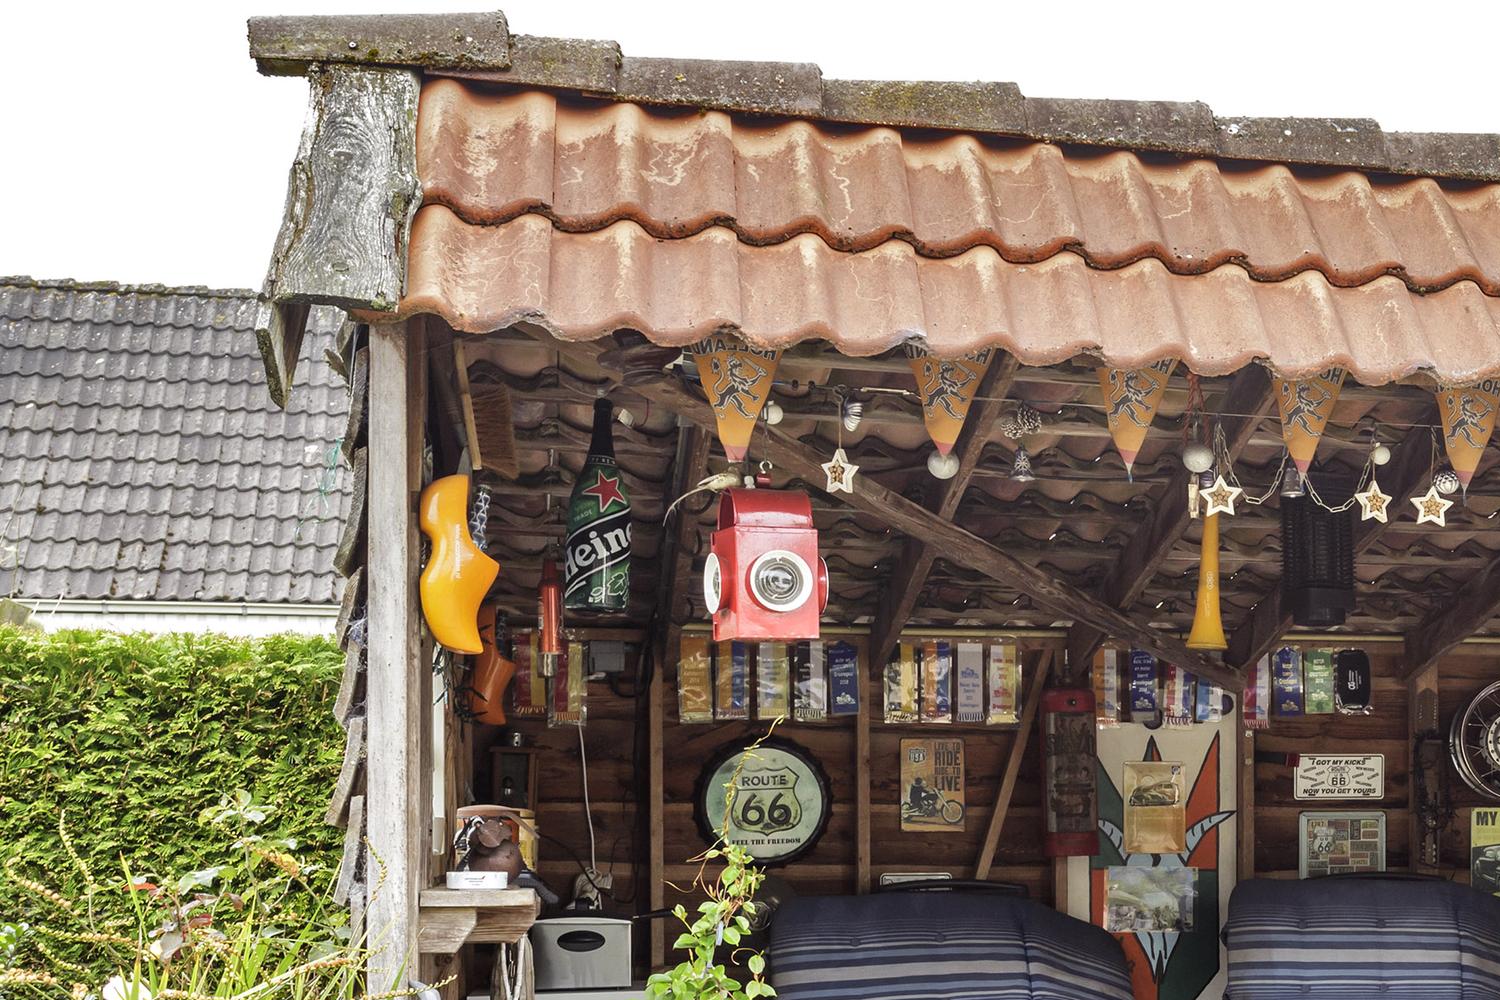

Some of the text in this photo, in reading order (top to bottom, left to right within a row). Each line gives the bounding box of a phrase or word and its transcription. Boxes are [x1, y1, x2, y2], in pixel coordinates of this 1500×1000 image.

[934, 750, 961, 766] RIDE
[953, 766, 961, 776] TO
[741, 775, 787, 786] ROUTE
[935, 775, 961, 791] LIVE
[1331, 776, 1346, 786] 66
[741, 792, 792, 826] 66
[1475, 811, 1498, 826] MY
[767, 837, 801, 845] FREEDOM
[1317, 841, 1331, 853] 66
